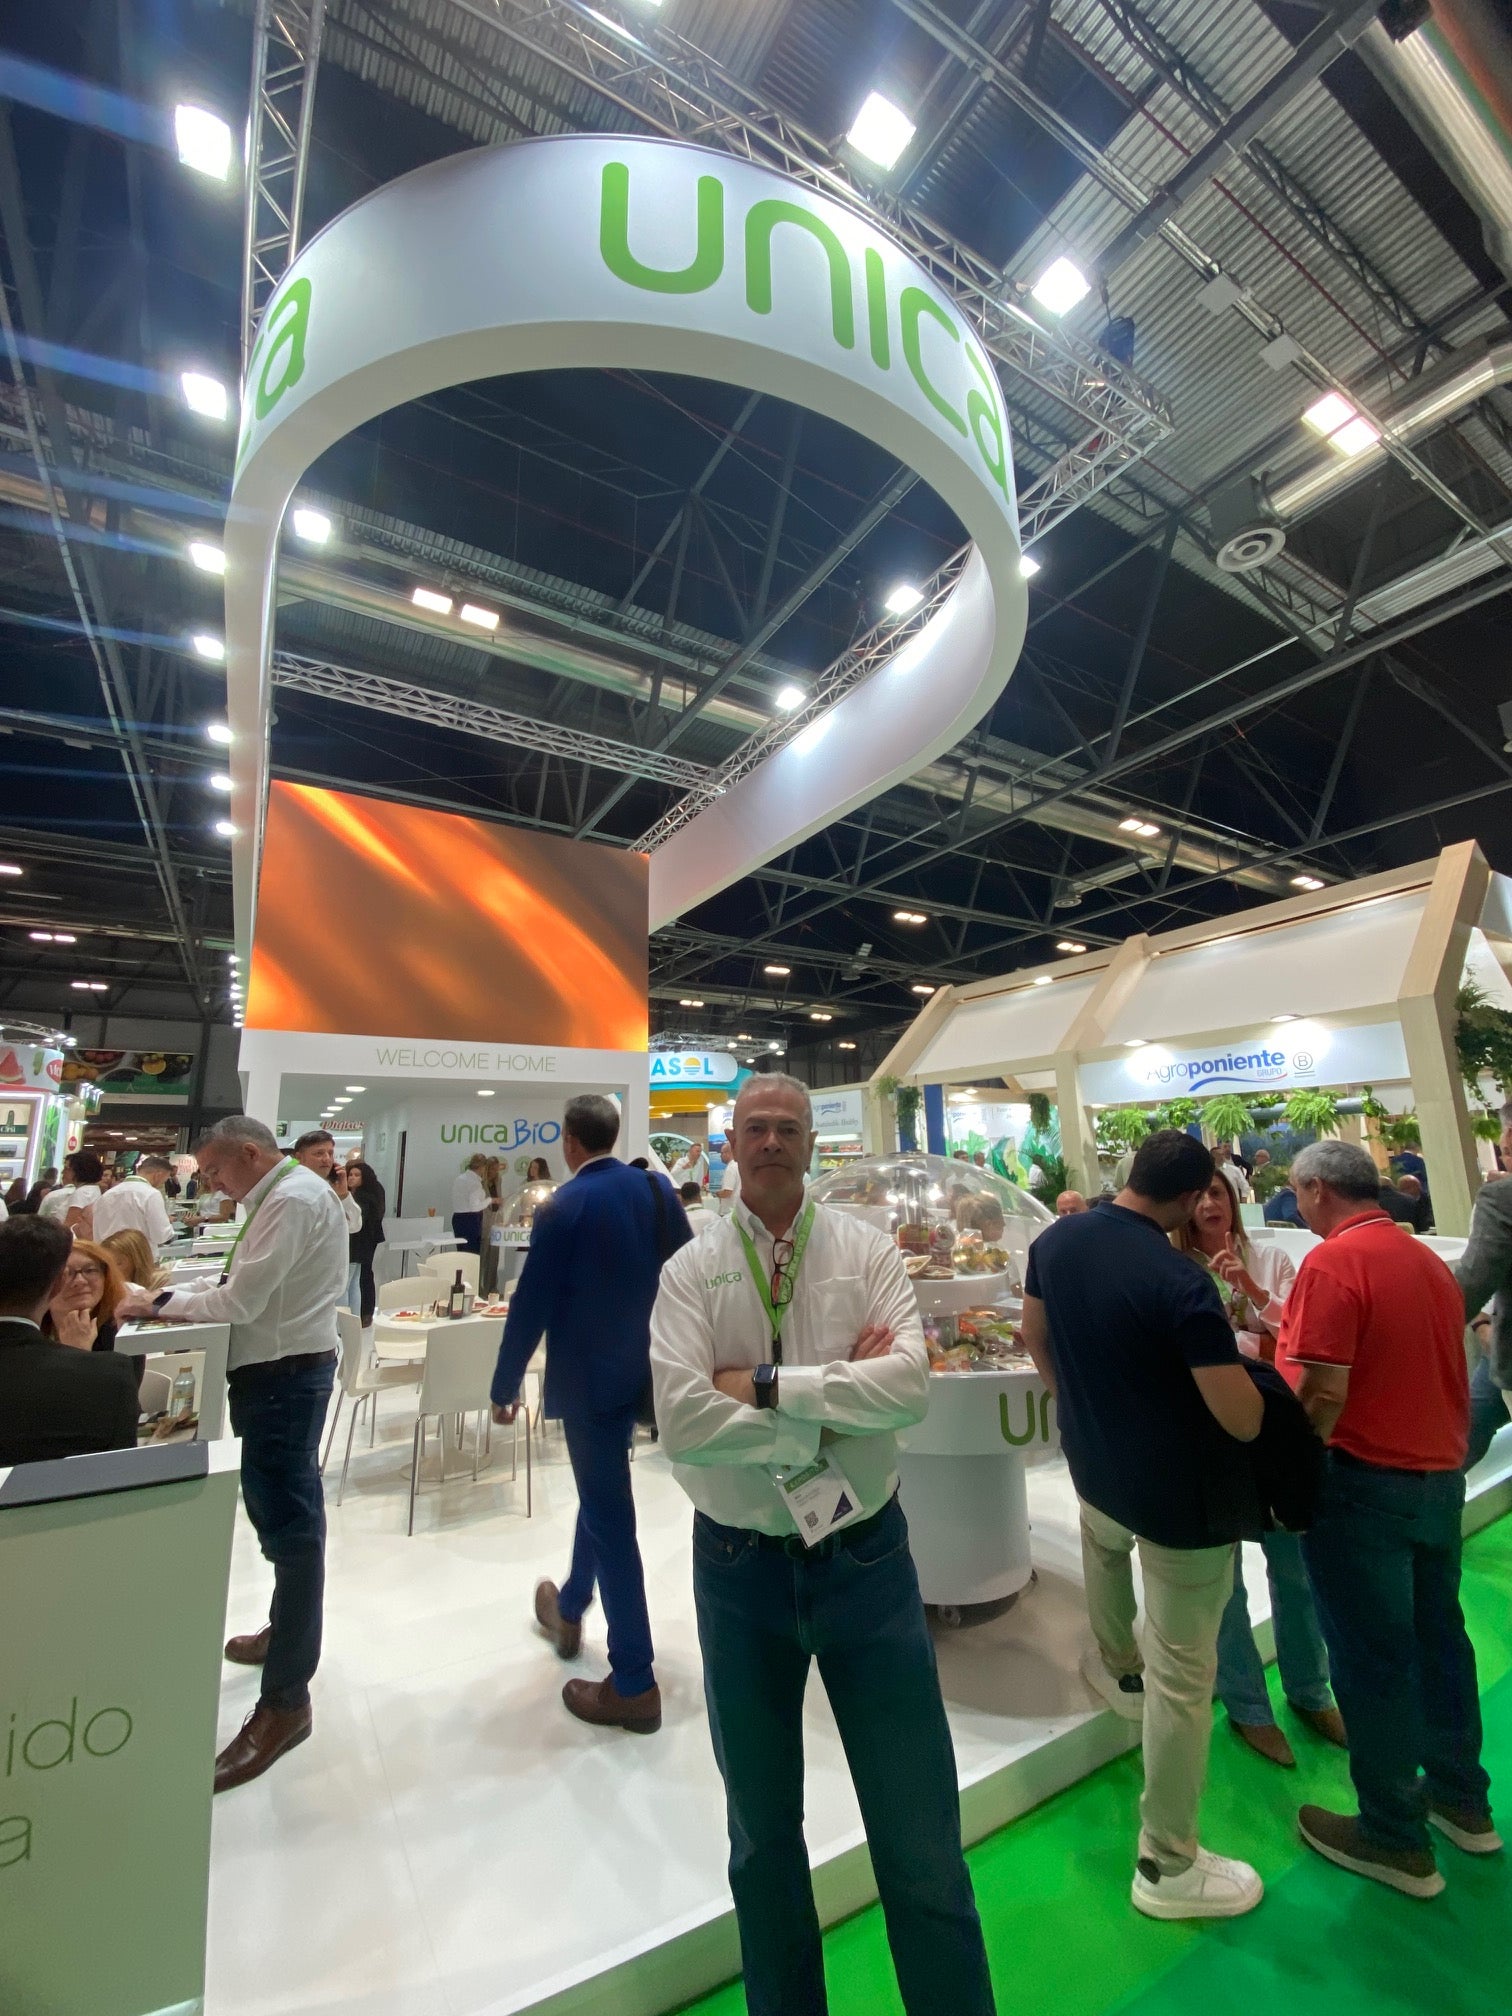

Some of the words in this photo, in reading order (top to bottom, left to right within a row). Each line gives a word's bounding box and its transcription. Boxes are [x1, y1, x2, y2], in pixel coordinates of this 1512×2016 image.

[601, 161, 1010, 505] unica
[377, 1048, 489, 1070] WELCOME
[497, 1054, 557, 1072] HOME
[1257, 1067, 1282, 1077] GRUPO
